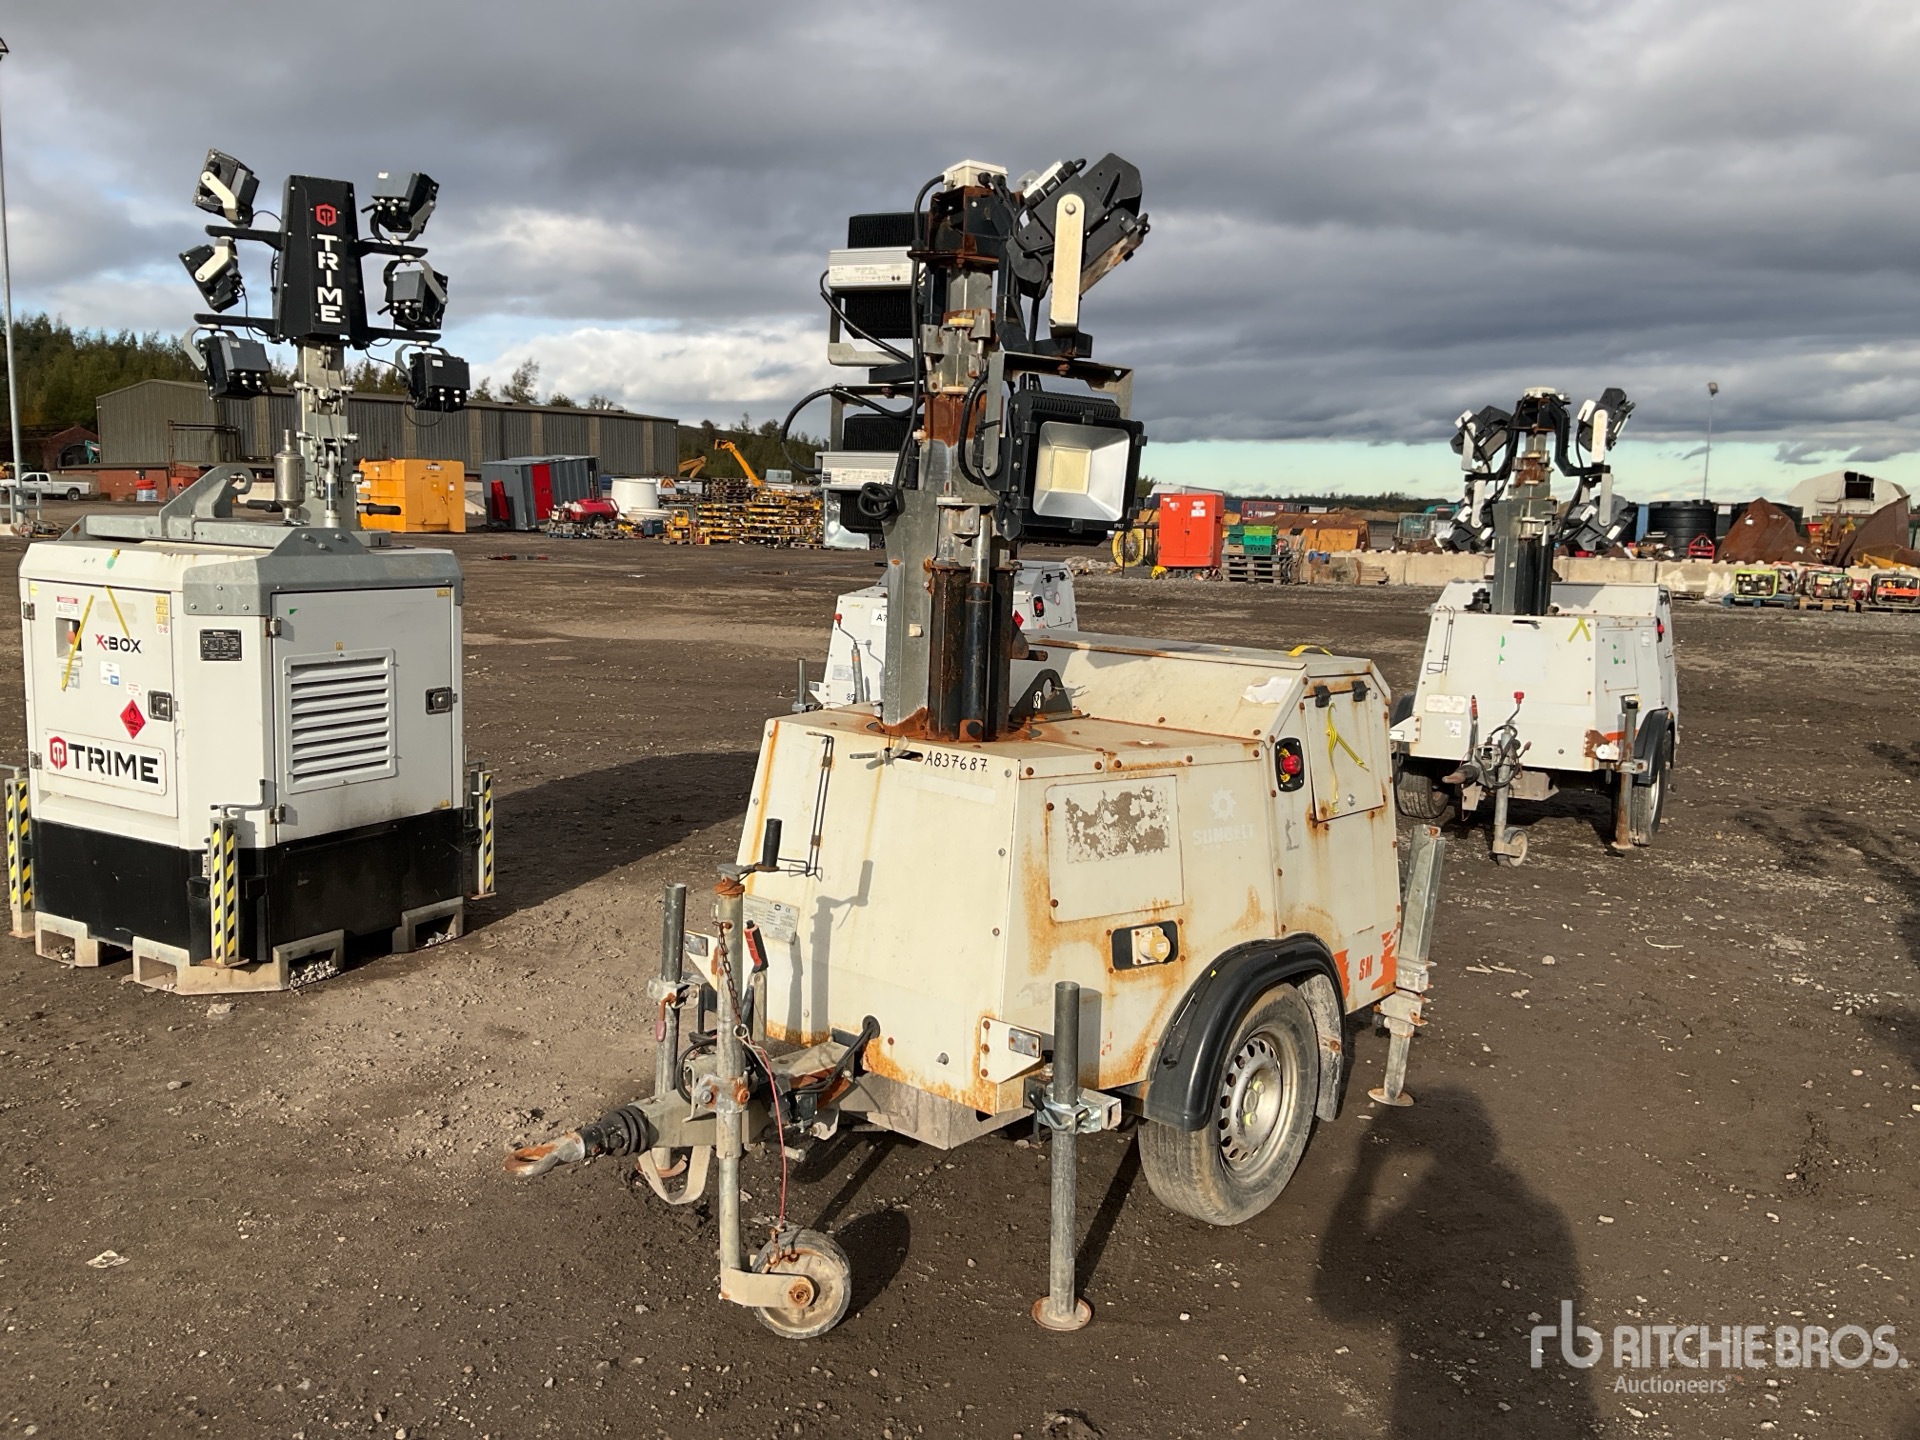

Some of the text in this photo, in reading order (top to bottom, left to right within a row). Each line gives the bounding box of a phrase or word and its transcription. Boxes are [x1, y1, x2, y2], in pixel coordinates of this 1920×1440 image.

[316, 233, 343, 323] TRIME
[94, 633, 142, 654] X-BOX
[67, 742, 159, 785] TRIME
